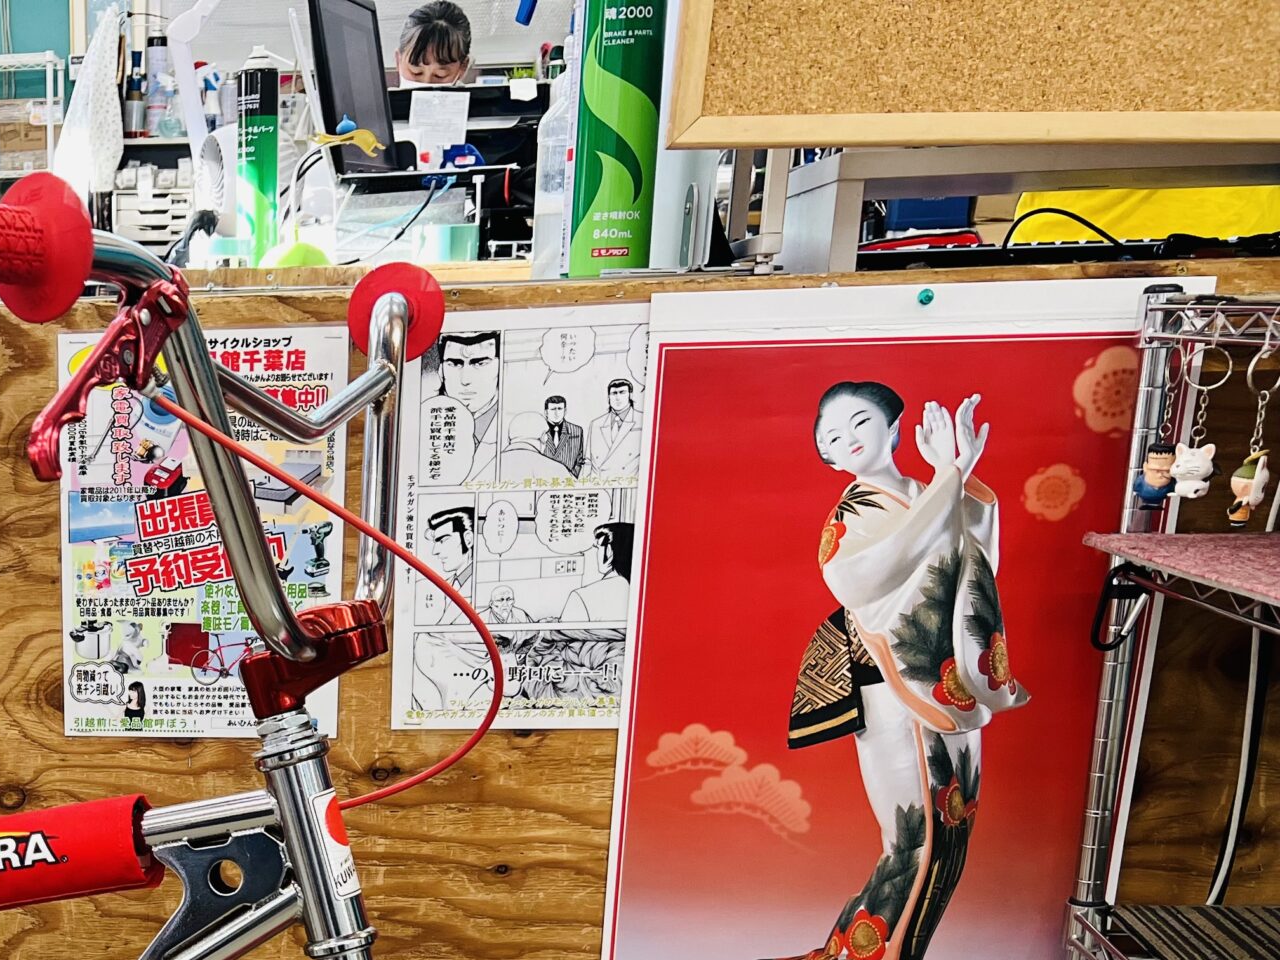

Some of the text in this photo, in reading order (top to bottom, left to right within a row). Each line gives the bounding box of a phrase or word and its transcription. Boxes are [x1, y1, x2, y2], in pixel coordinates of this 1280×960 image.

[603, 30, 626, 38] BRAKE
[603, 38, 635, 46] CLEANER
[592, 229, 633, 240] 840mL
[204, 335, 293, 350] サイクルショップ
[80, 494, 142, 502] 買取対象となります
[132, 529, 221, 555] 買替や引越前の不
[425, 593, 434, 609] はい
[76, 669, 109, 683] 荷物減って
[76, 683, 119, 697] 楽チン引越し！
